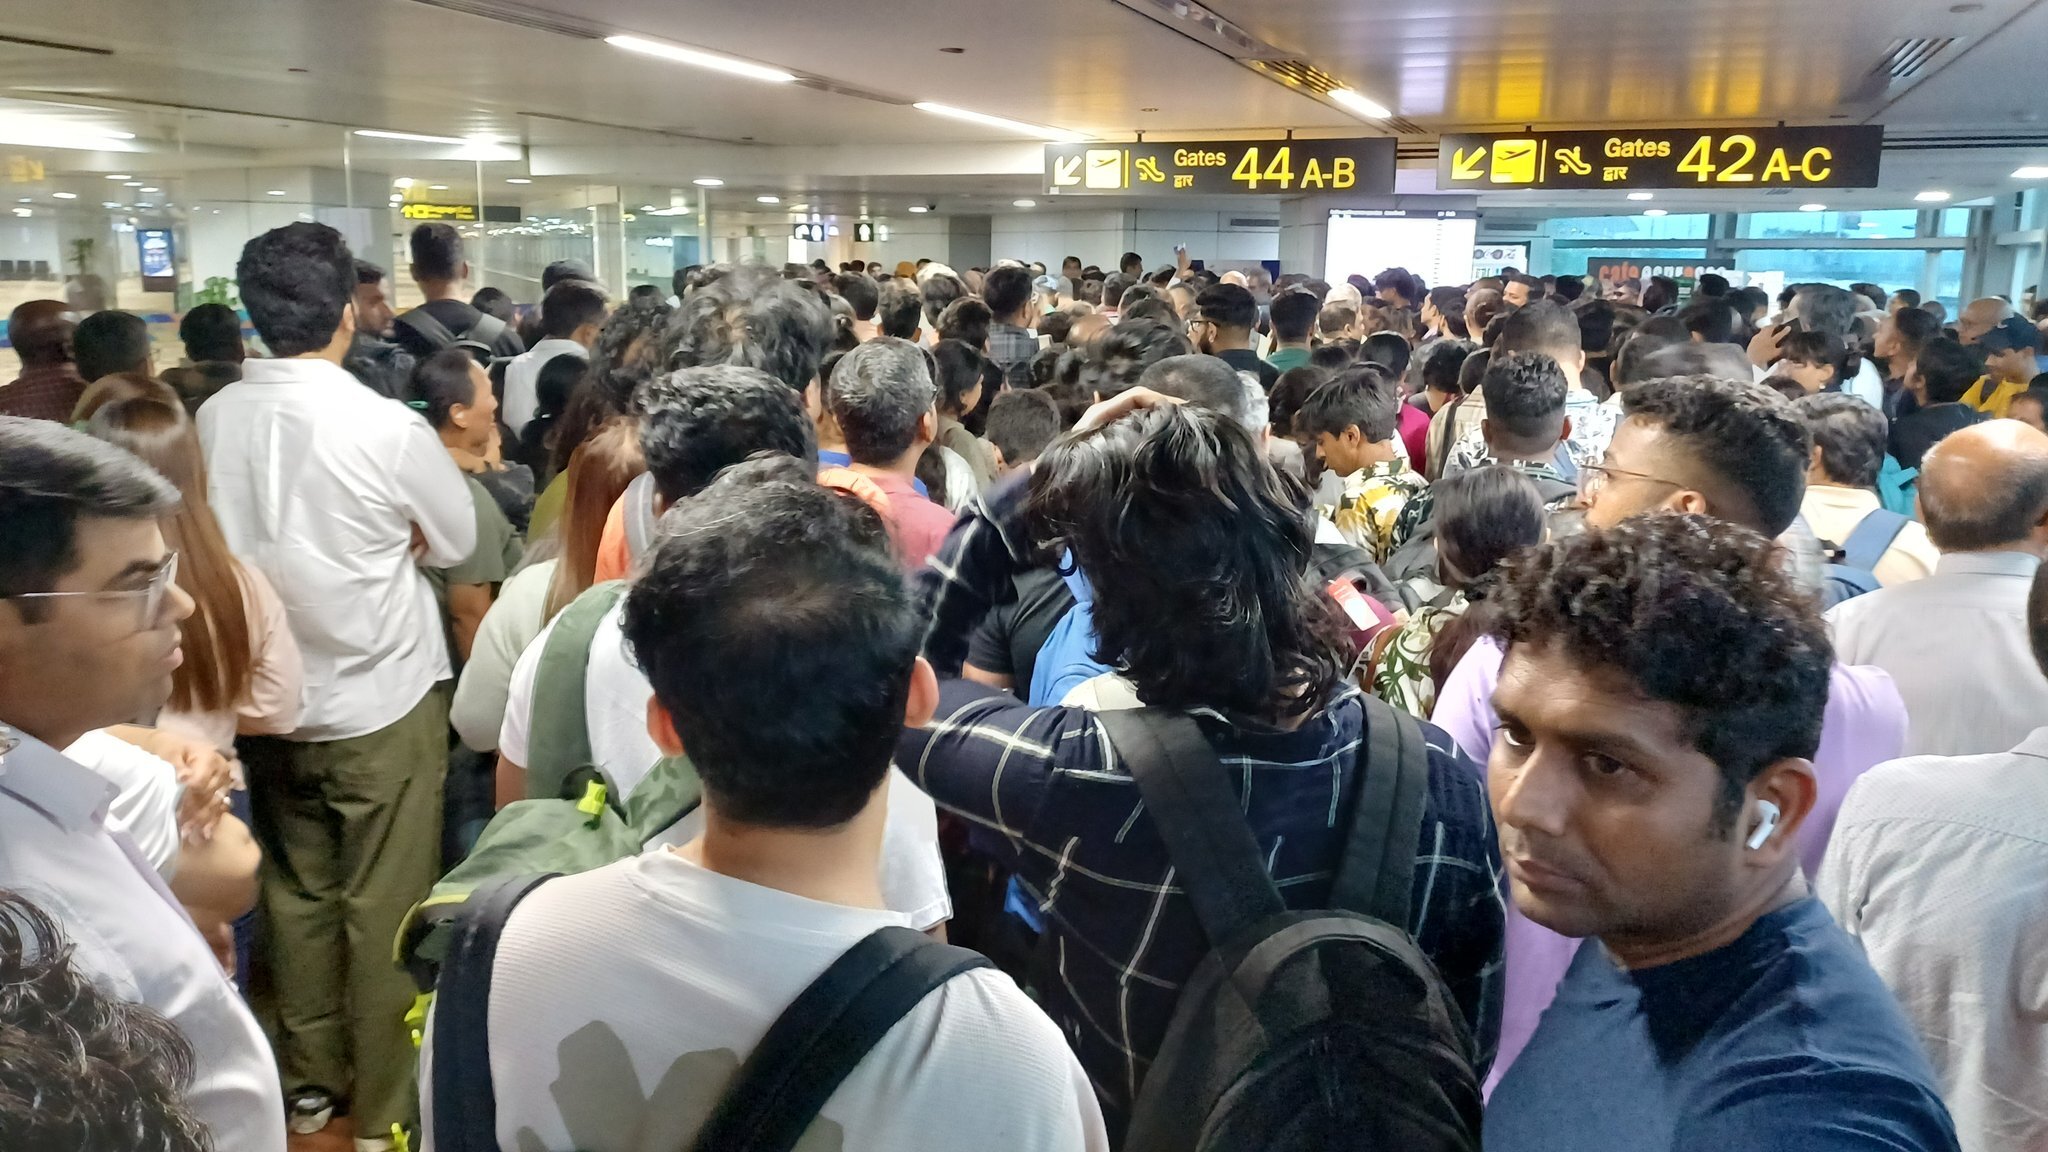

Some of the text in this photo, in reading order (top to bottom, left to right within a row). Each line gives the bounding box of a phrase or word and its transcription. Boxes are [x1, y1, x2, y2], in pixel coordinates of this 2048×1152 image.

[1173, 146, 1356, 189] Gates 44 A-B
[1603, 133, 1833, 183] Gates 42 A-C
[1173, 173, 1195, 189] द्वार
[1602, 165, 1629, 182] द्वार
